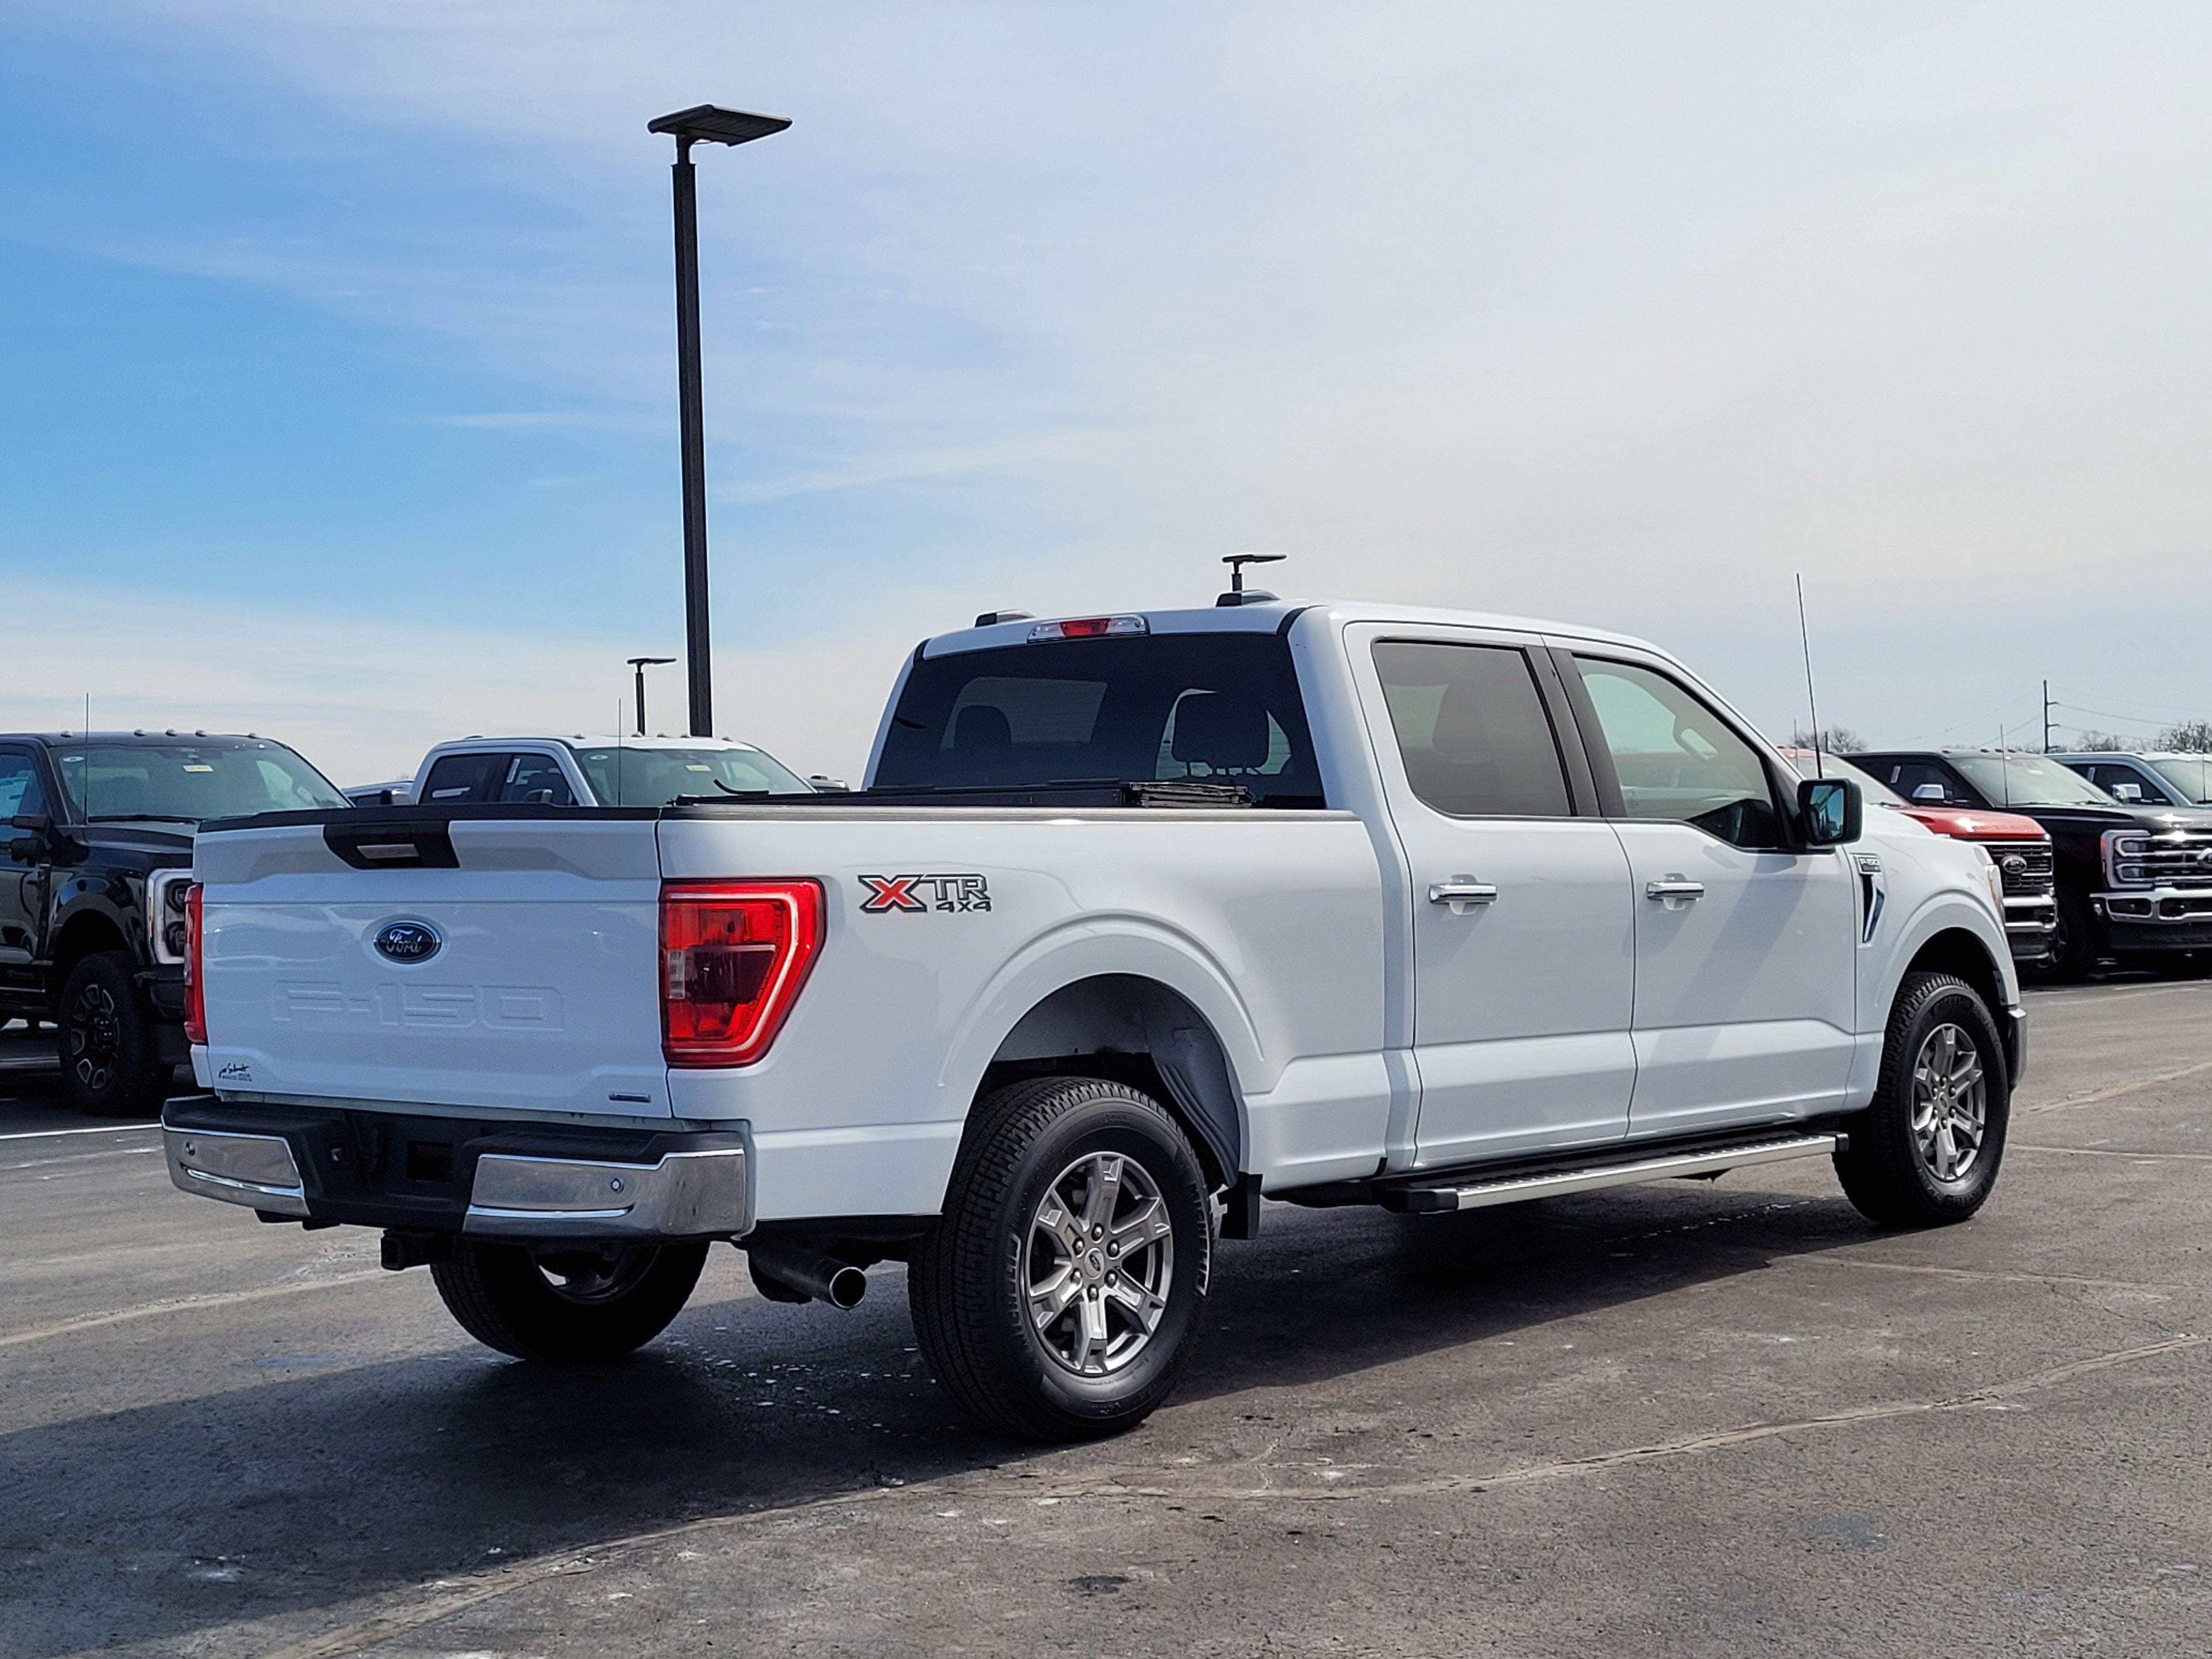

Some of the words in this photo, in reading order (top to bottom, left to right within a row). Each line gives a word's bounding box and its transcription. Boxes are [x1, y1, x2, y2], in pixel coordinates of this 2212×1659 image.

[857, 874, 991, 913] XTR
[386, 928, 422, 953] Ford
[274, 980, 563, 1031] F-150
